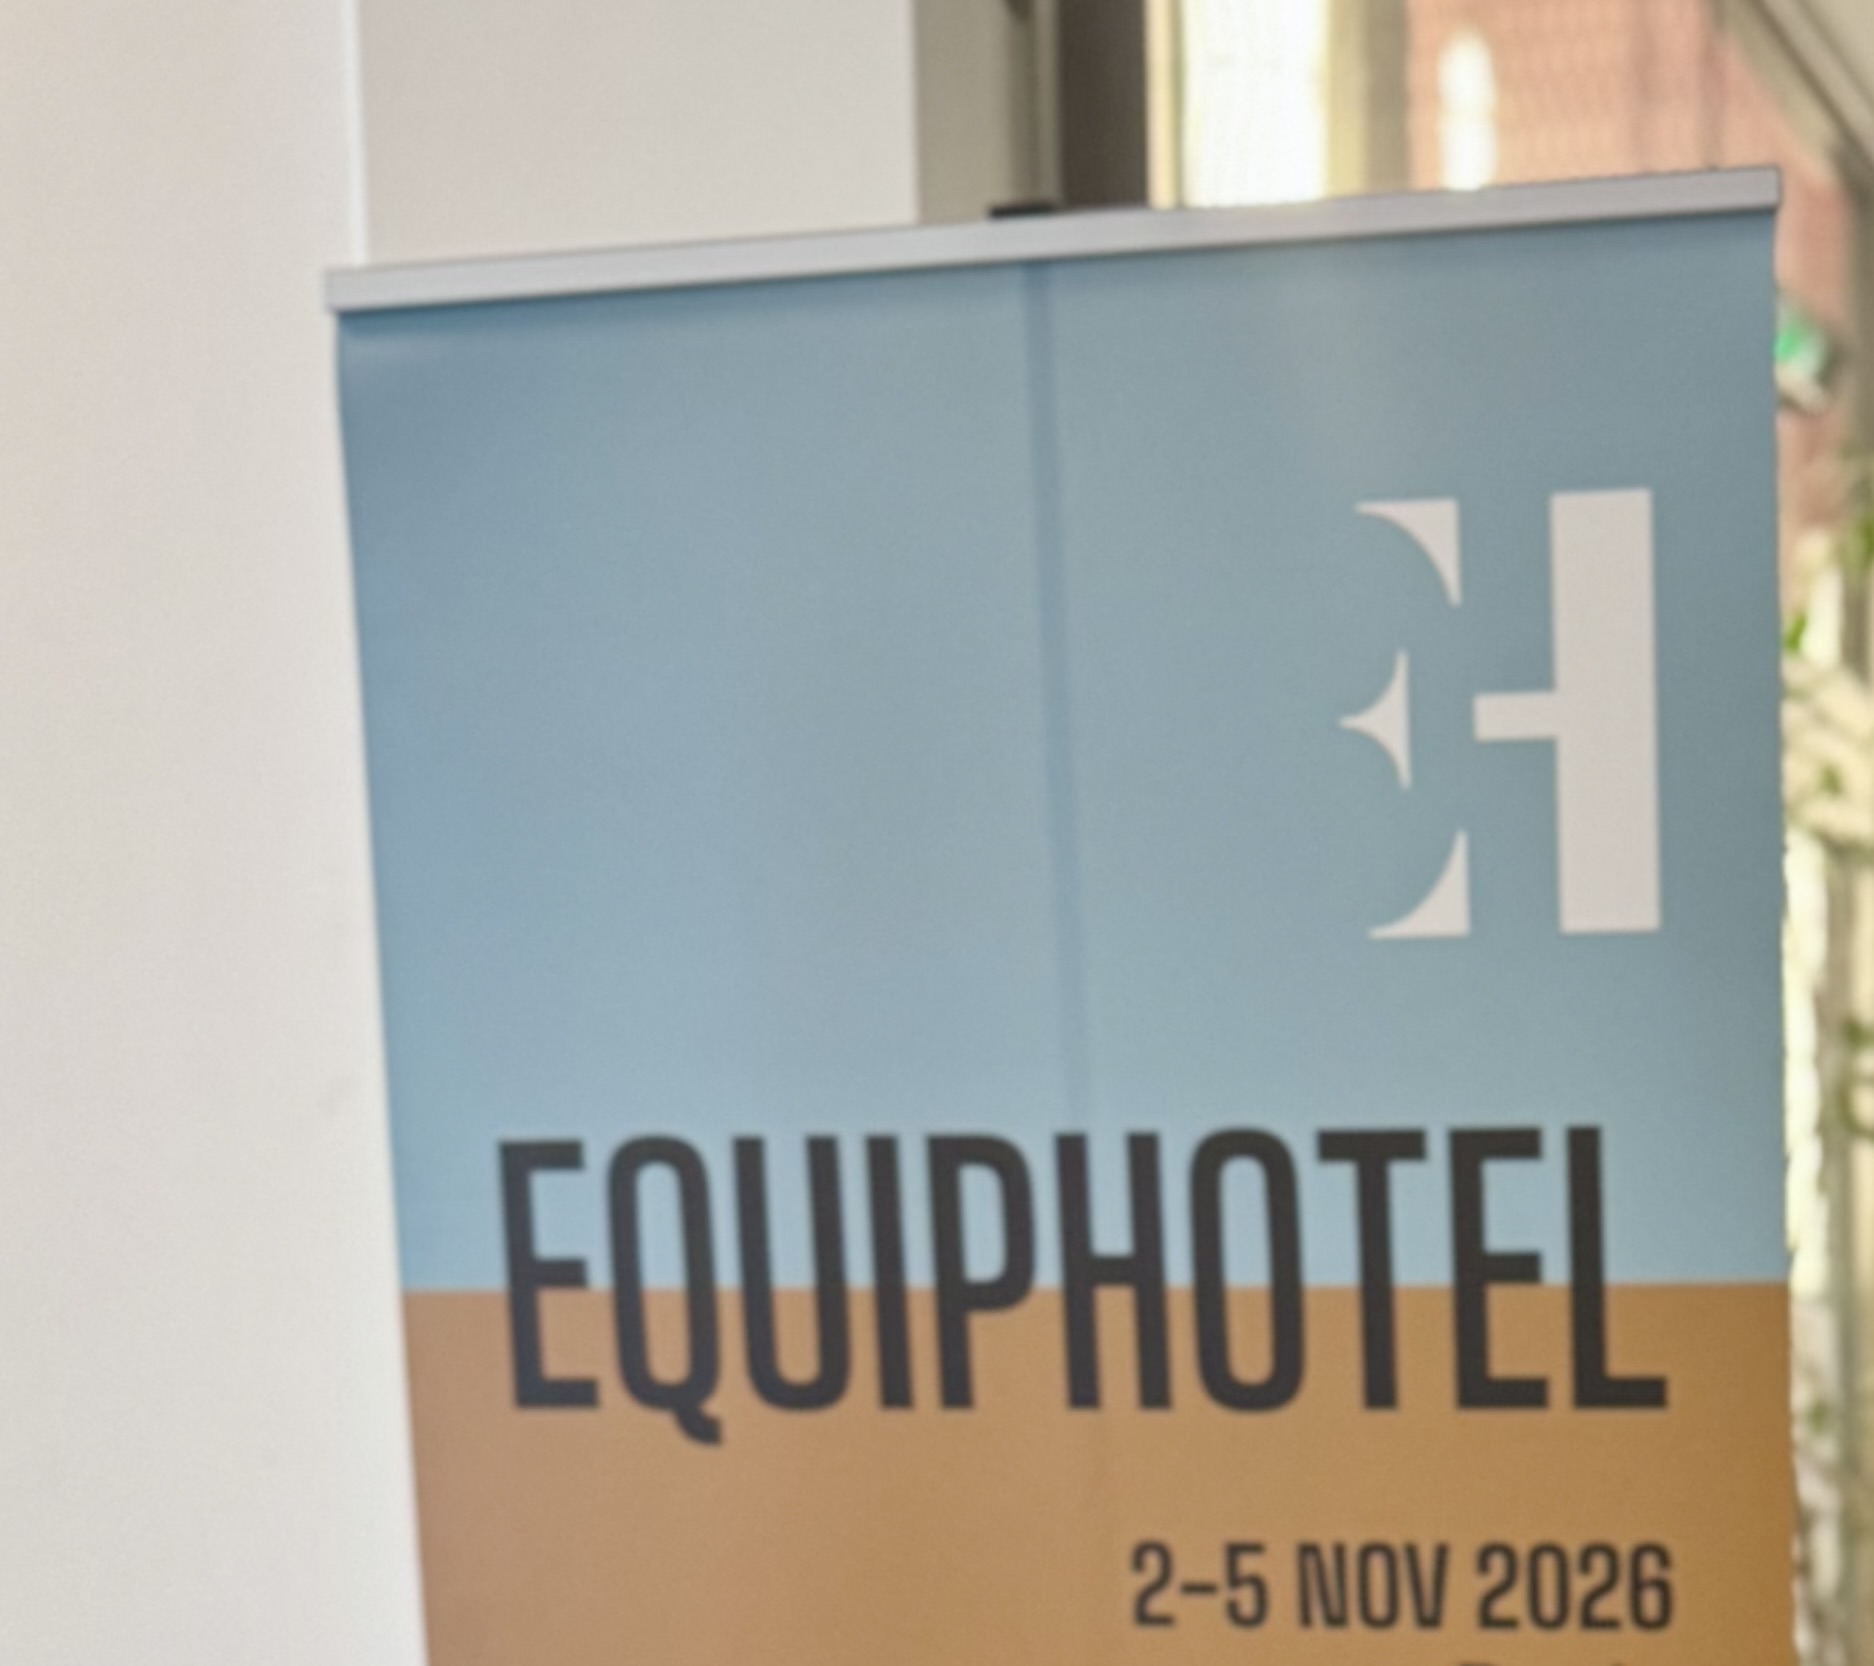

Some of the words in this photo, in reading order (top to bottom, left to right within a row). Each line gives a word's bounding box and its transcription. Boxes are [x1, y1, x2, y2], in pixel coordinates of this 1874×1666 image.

[496, 1123, 1669, 1447] EQUIPHOTEL
[1294, 1539, 1452, 1633] NOV
[1473, 1539, 1676, 1634] 2026
